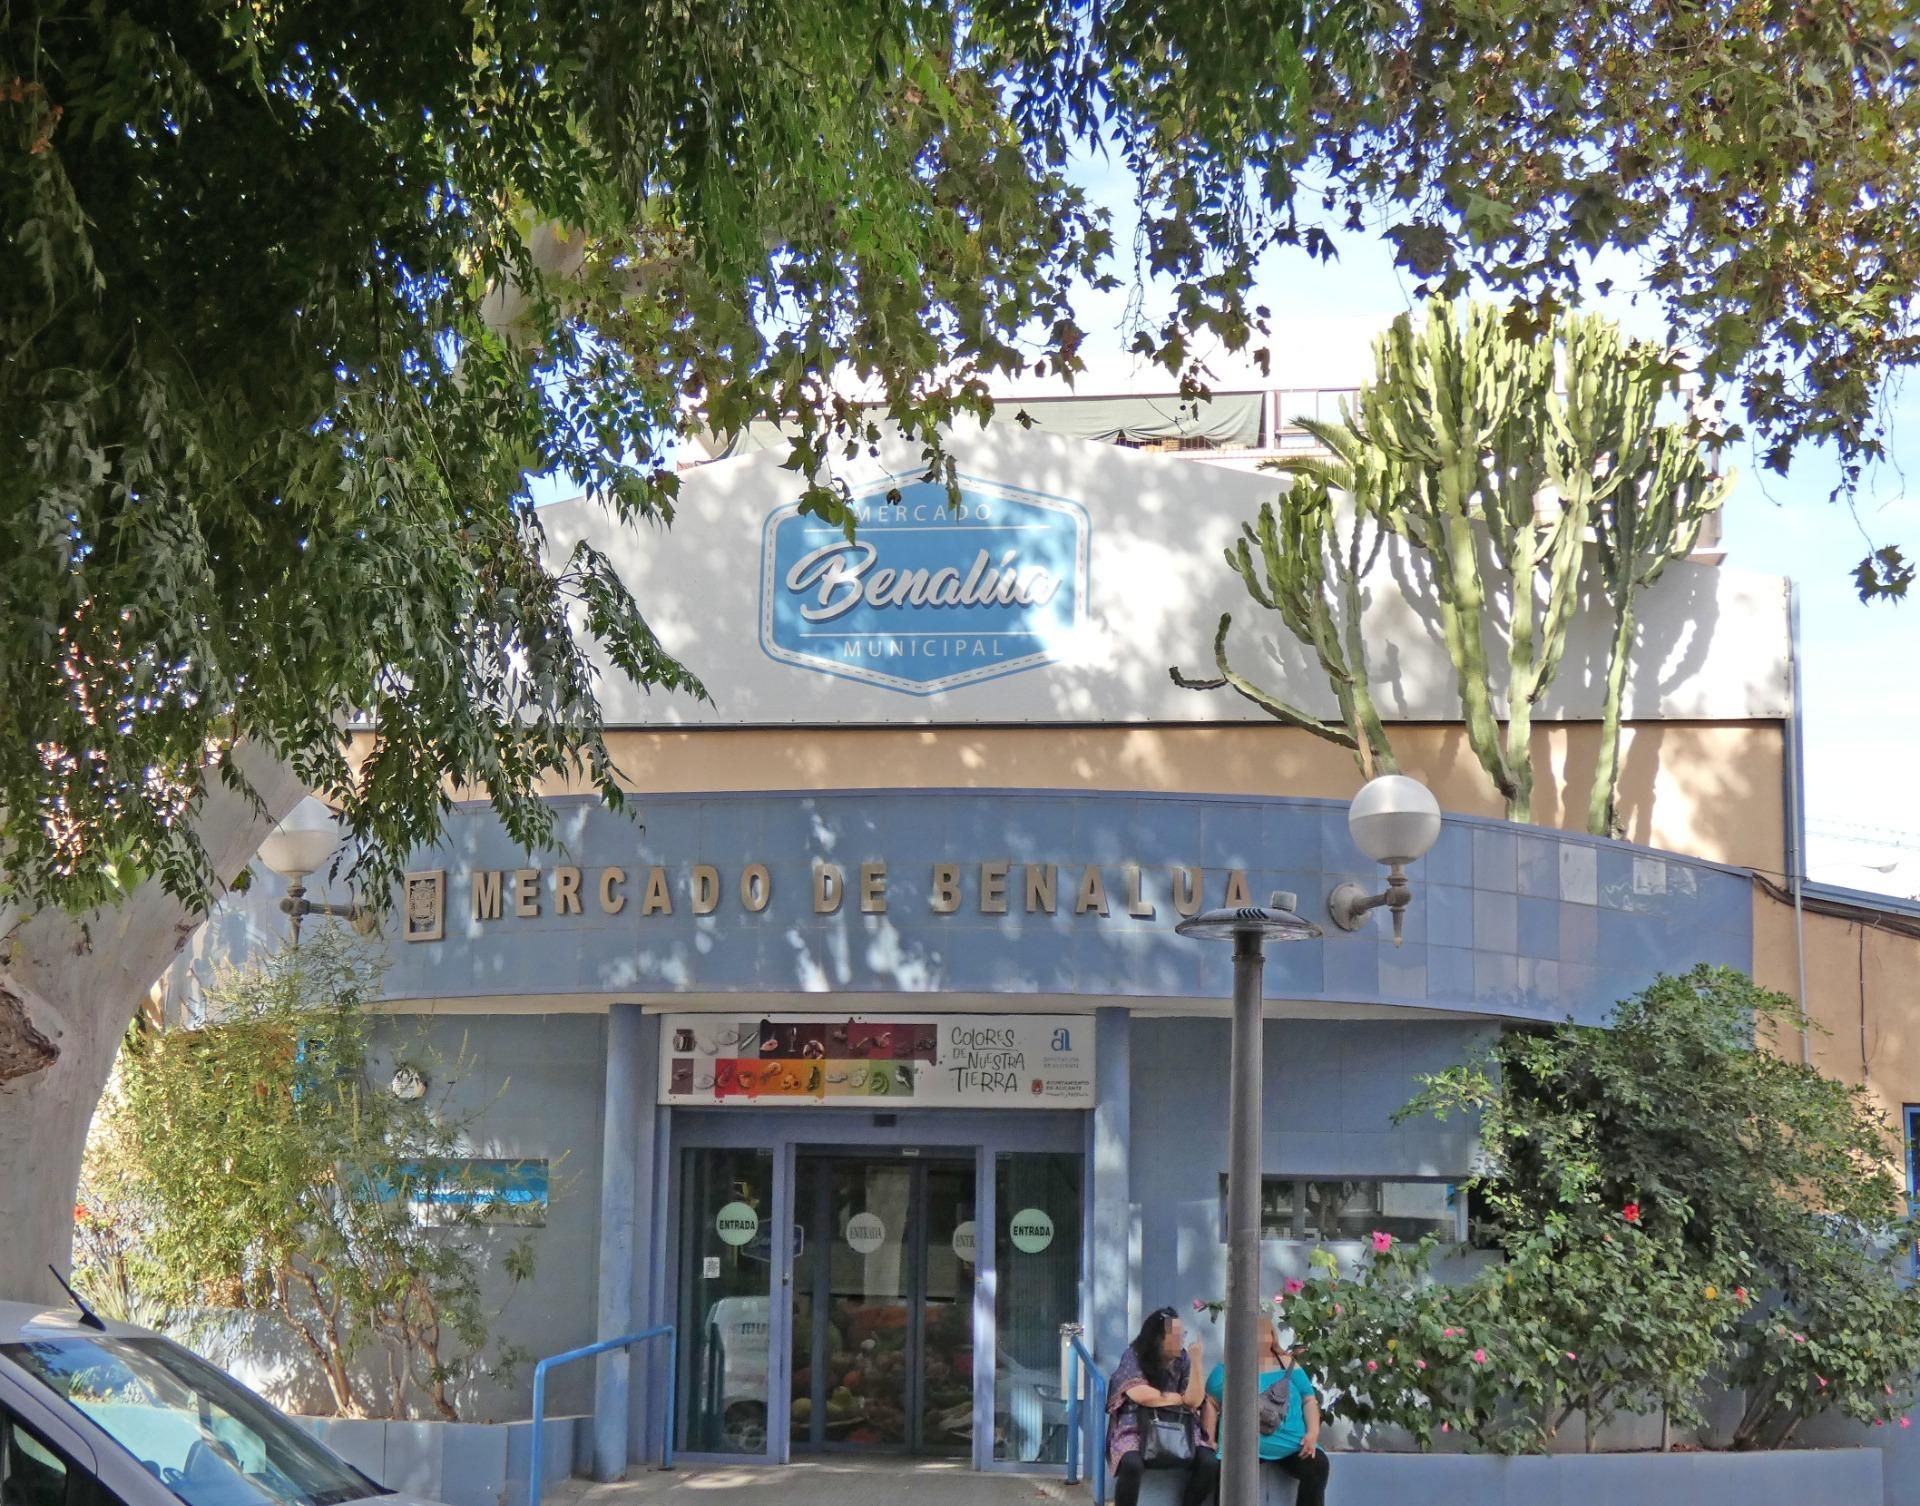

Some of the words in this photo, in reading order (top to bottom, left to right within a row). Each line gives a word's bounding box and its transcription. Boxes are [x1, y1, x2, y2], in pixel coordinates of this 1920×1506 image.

[855, 503, 992, 523] MERCADO
[786, 541, 1062, 623] Benalúa
[843, 639, 1004, 658] MUNICIPAL
[471, 863, 772, 920] MERCADO
[814, 863, 888, 914] DE
[932, 863, 1252, 917] BENALUA
[952, 1026, 1016, 1050] COLORES
[953, 1048, 966, 1059] DE
[967, 1052, 1025, 1071] NUESTRA
[948, 1066, 1018, 1092] TIERRA
[719, 1220, 756, 1230] ENTRADA
[1013, 1225, 1050, 1236] ENTRADA
